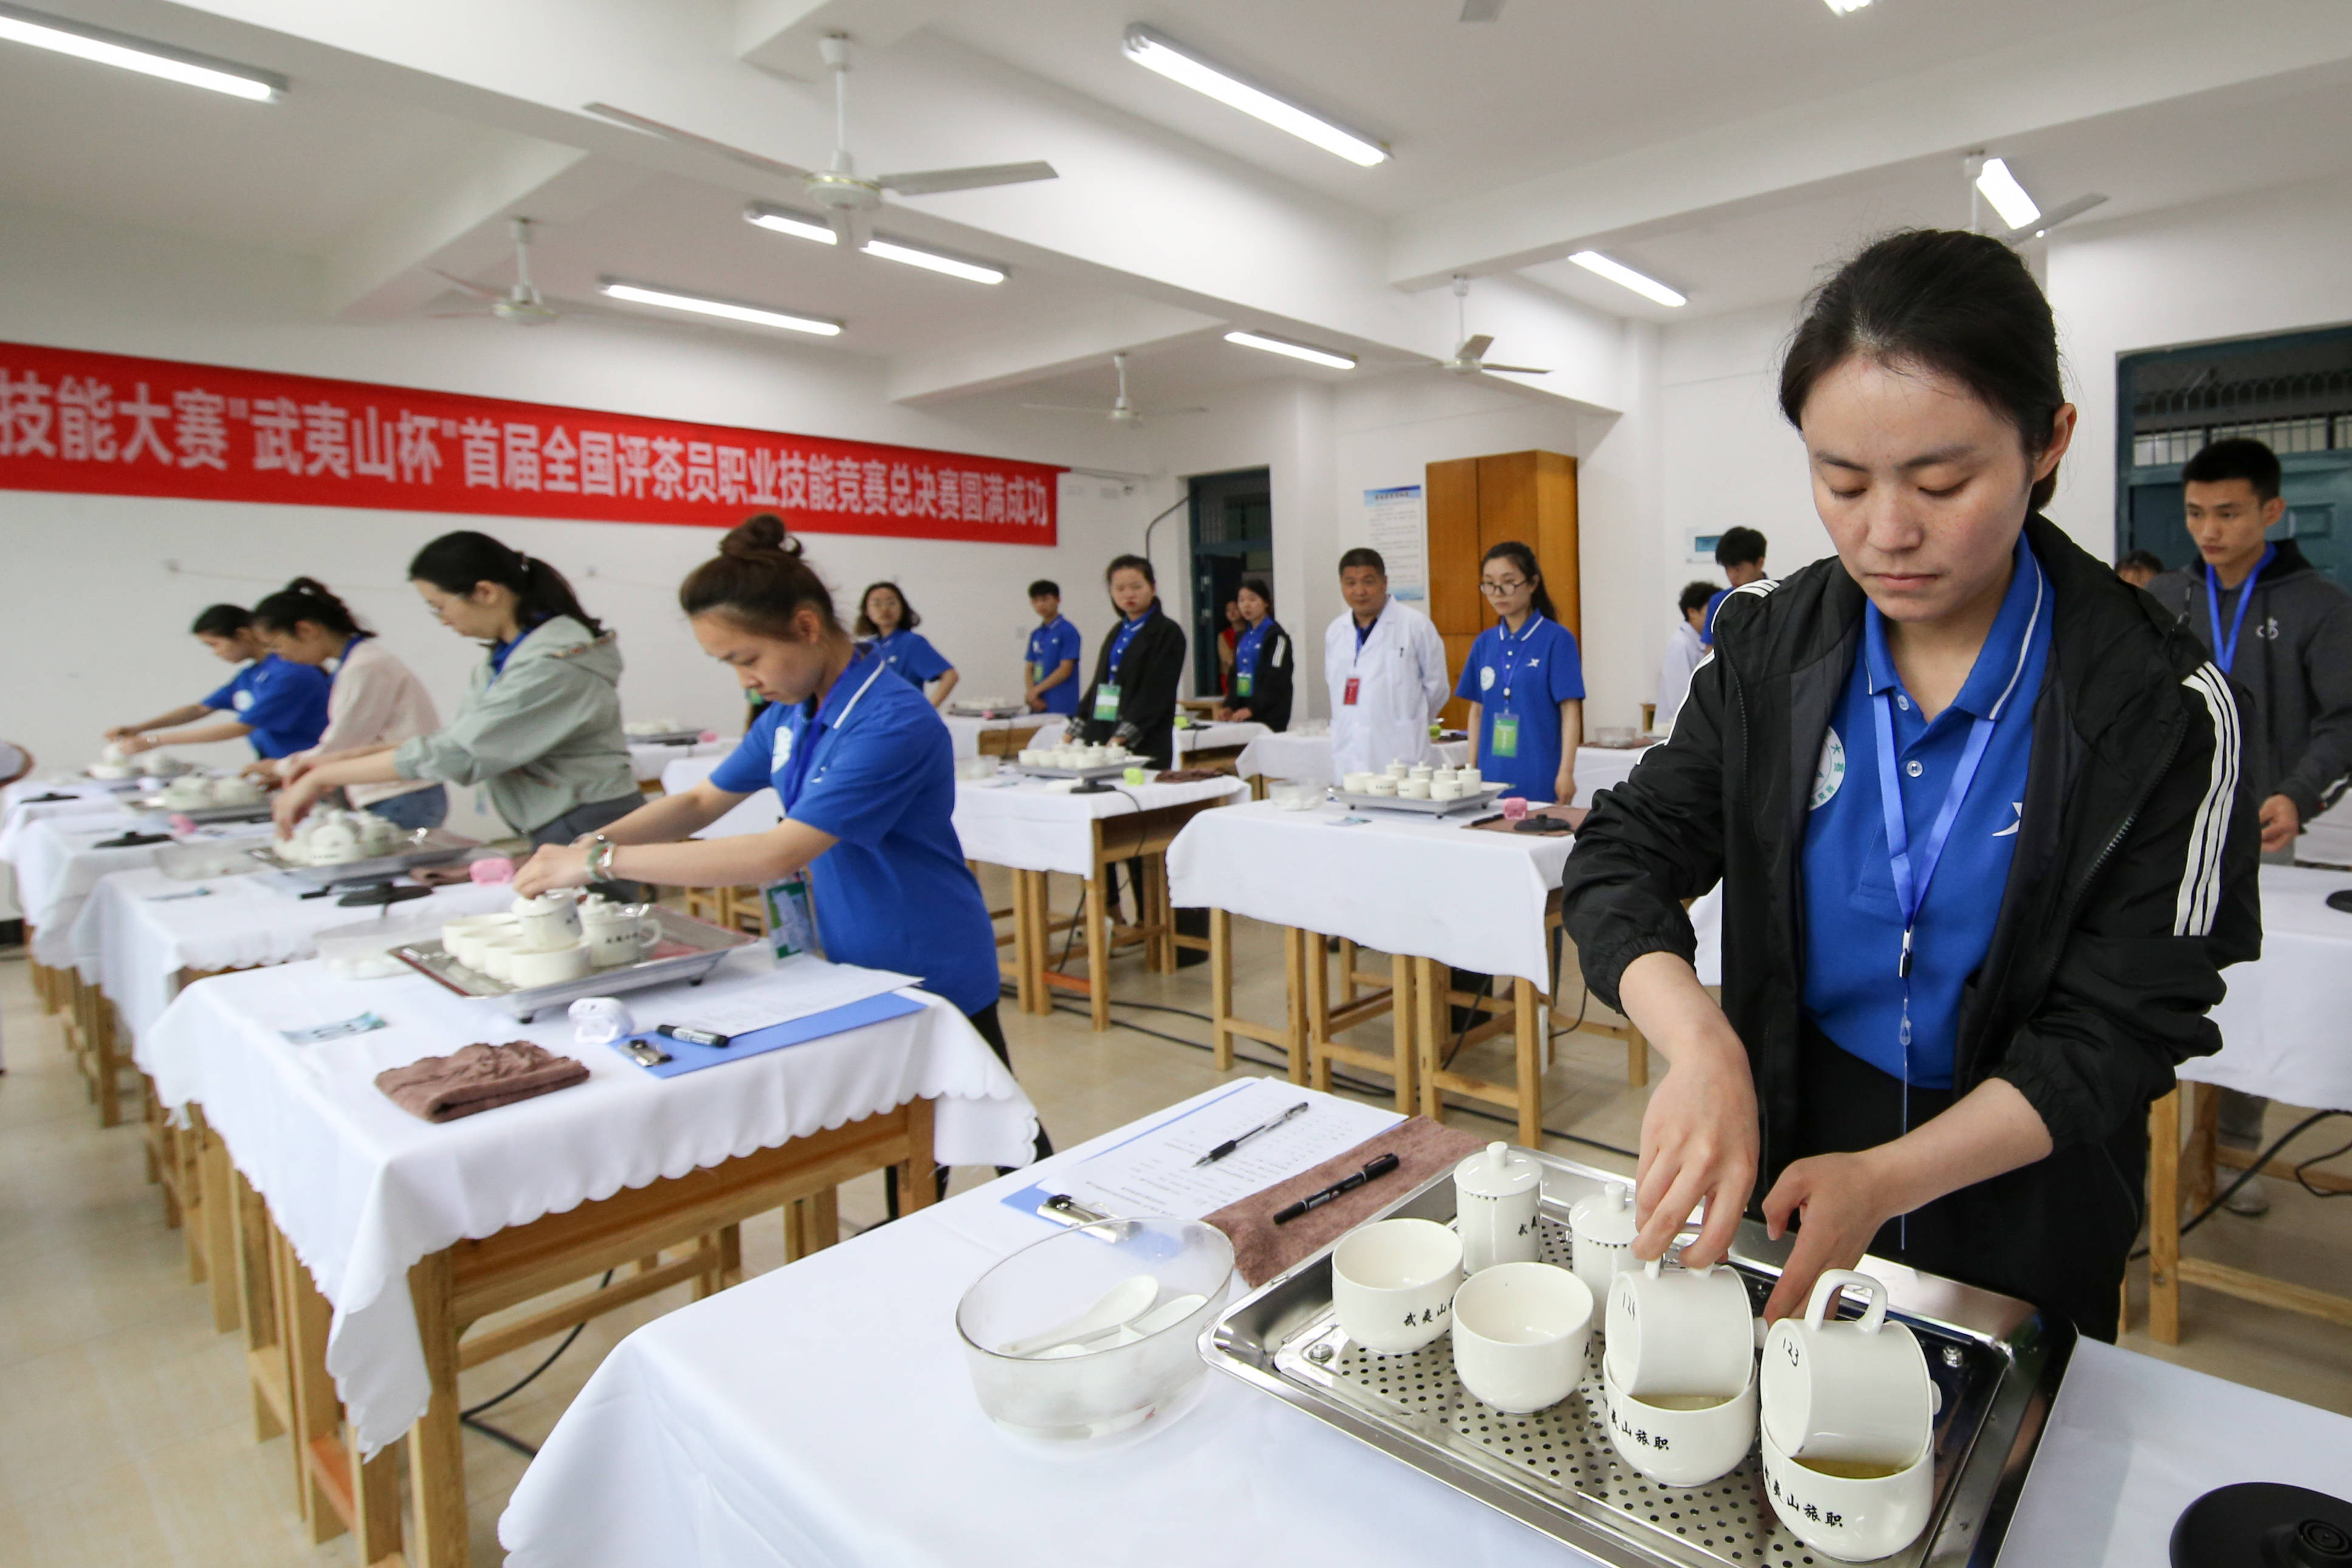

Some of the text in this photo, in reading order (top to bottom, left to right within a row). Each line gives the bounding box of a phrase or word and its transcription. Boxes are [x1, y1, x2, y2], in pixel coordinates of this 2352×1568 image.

[1404, 1294, 1454, 1327] 武夷山
[1782, 1337, 1800, 1367] 123
[1604, 1396, 1669, 1451] 夷山旅职
